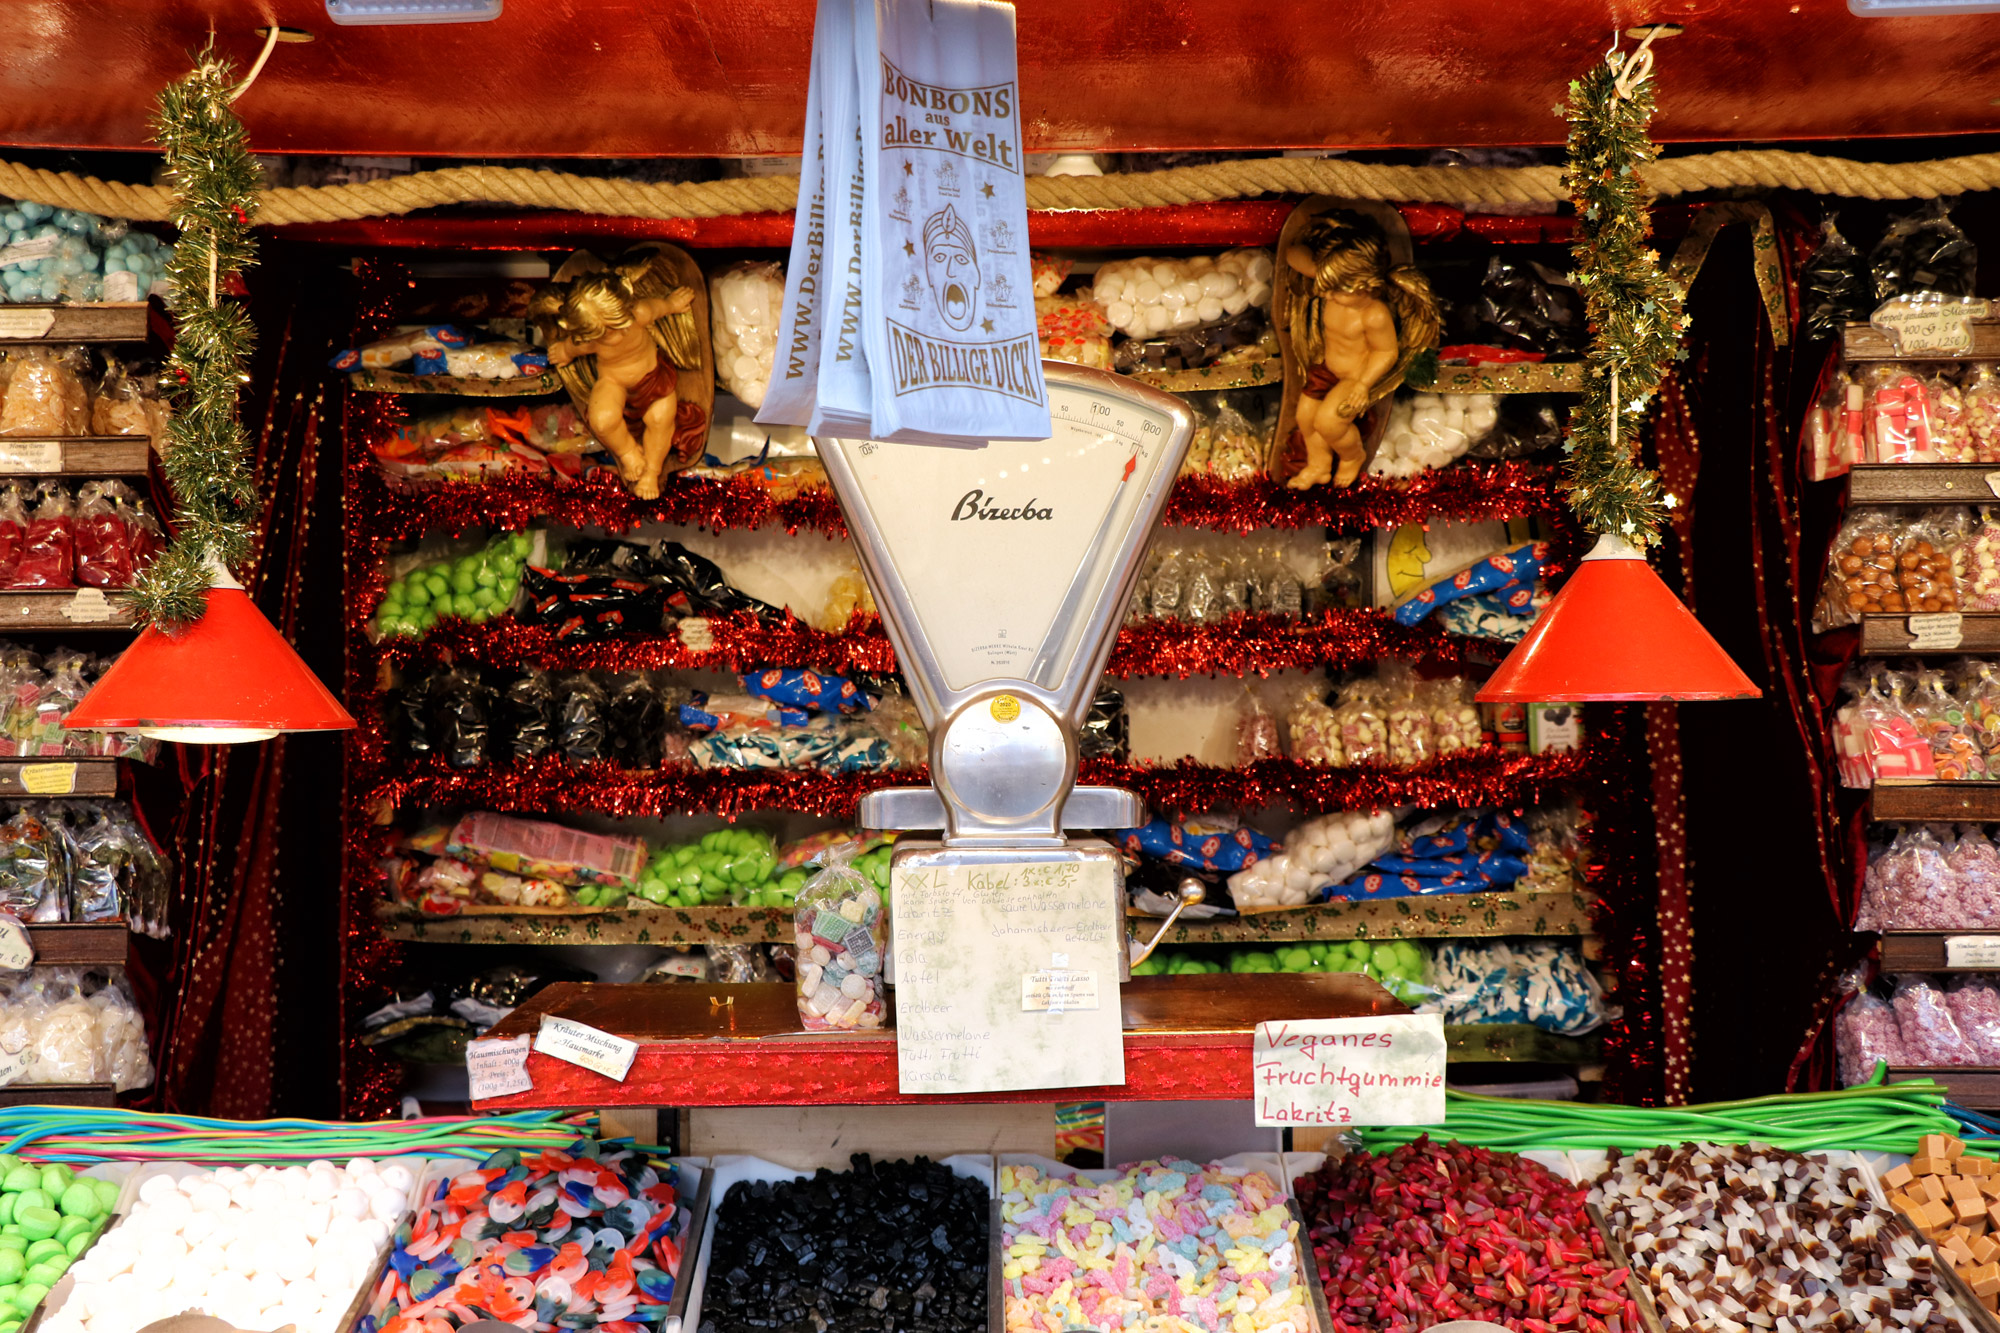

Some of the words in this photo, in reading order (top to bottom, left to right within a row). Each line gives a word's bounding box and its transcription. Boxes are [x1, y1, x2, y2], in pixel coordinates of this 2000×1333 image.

[884, 62, 1010, 118] BONBONS
[925, 113, 950, 126] aus
[884, 115, 936, 145] aller
[943, 127, 1013, 168] Welt
[892, 327, 929, 390] DER
[926, 341, 992, 386] BILLIGE
[991, 340, 1038, 400] DICK
[1116, 419, 1125, 427] 50
[950, 488, 1053, 521] Bizerba
[899, 869, 948, 891] XXL
[897, 928, 945, 946] Energy
[898, 949, 928, 964] Cola
[901, 968, 939, 985] Apfel
[900, 1000, 952, 1014] Erdbeer
[553, 1022, 585, 1040] Kräuter
[584, 1033, 623, 1055] Mischung
[899, 1025, 991, 1041] Wassermelone
[1263, 1022, 1393, 1061] Veganes
[469, 1047, 527, 1060] Hausmischungen
[558, 1038, 605, 1060] Hausmarke
[901, 1047, 933, 1061] Tutti
[940, 1045, 982, 1061] Frutti
[476, 1060, 497, 1070] Inhalt
[503, 1058, 520, 1068] 400g
[1256, 1061, 1443, 1098] Fruchtgummie
[1262, 1096, 1352, 1124] Lakritz
